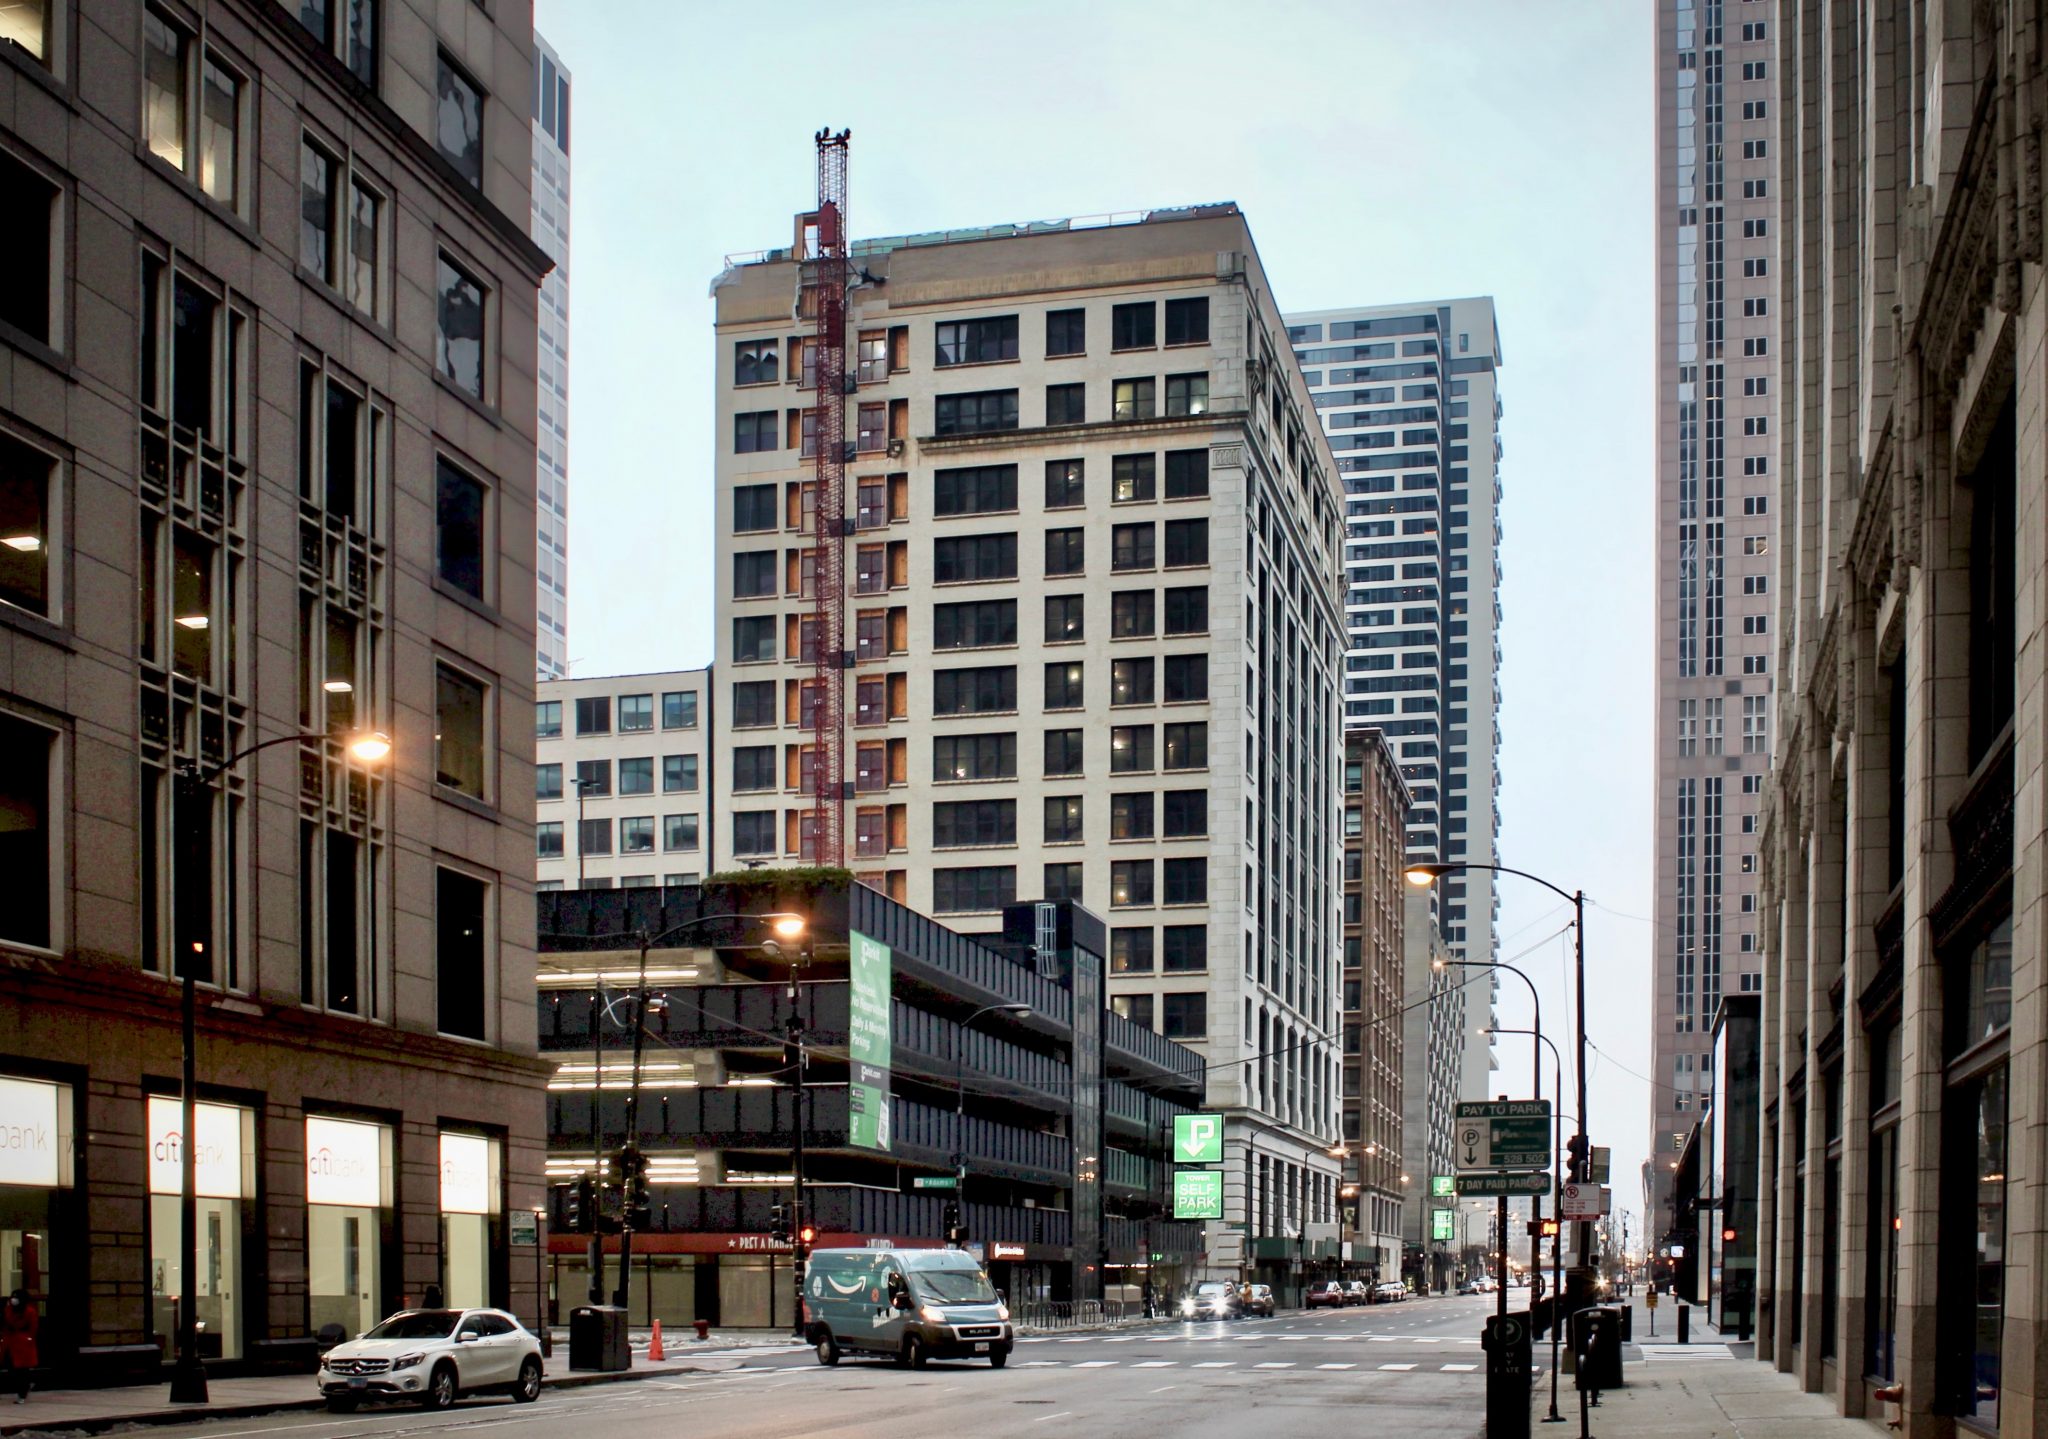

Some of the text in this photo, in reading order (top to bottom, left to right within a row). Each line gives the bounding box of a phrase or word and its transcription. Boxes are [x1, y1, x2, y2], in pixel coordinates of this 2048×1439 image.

[1462, 1103, 1543, 1116] PAY TO PARK
[1525, 1154, 1545, 1163] 502
[1179, 1183, 1216, 1196] SELF
[1459, 1181, 1464, 1189] 7
[1466, 1180, 1484, 1190] DAY
[1486, 1179, 1504, 1189] PAID
[1178, 1196, 1217, 1209] PARK
[739, 1236, 758, 1249] PRET
[760, 1237, 766, 1249] A
